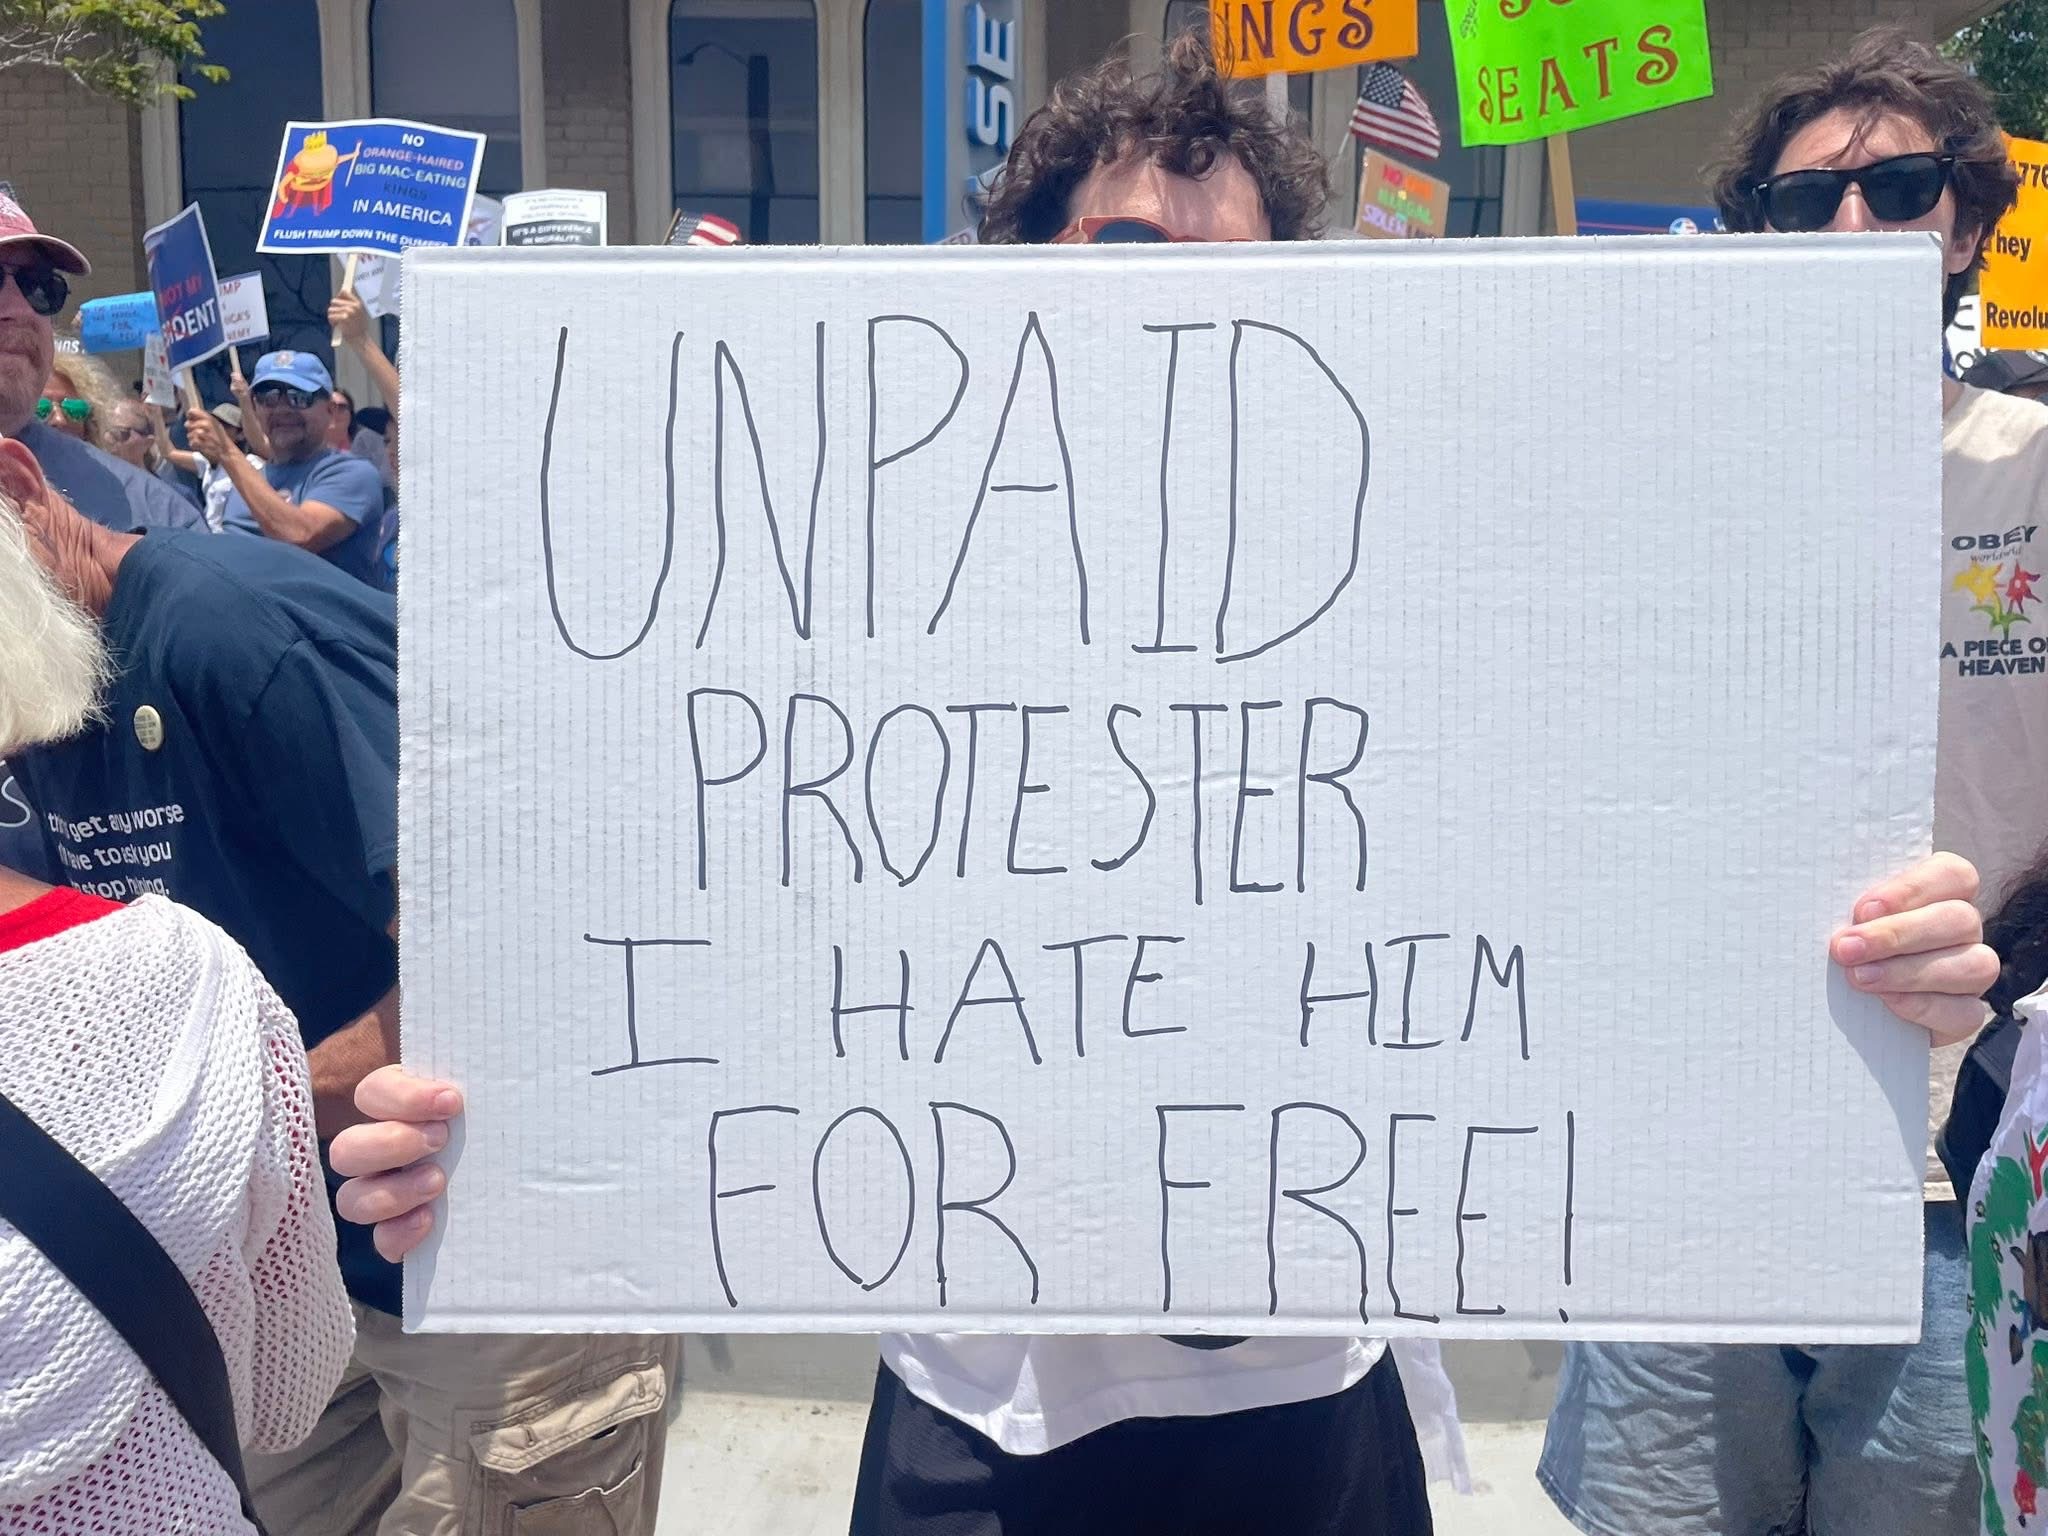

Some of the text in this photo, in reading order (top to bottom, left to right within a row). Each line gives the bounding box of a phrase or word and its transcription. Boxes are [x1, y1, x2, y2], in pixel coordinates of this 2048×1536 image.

[1477, 24, 1679, 125] SEATS
[401, 133, 425, 147] NO
[363, 147, 464, 171] ORANGE-HAIRED
[354, 163, 467, 189] BIG MAC-EATING
[352, 199, 453, 227] IN AMERICA
[274, 229, 305, 239] FLUSH
[307, 229, 341, 239] TRUMP
[341, 229, 373, 239] DOWN
[375, 230, 398, 243] THE
[541, 312, 1370, 664] UNPAID
[1951, 525, 2038, 550] OBEY
[1940, 642, 1958, 658] A
[1964, 639, 2024, 657] PIECE
[1958, 656, 2046, 677] HEAVEN
[687, 688, 1369, 905] PROTESTER
[68, 815, 108, 842] get
[108, 812, 133, 834] any
[131, 804, 185, 829] worse
[93, 847, 122, 866] to
[138, 841, 172, 867] you
[584, 934, 1530, 1076] I HATE HIM
[708, 1102, 1575, 1325] FOR FREE!
